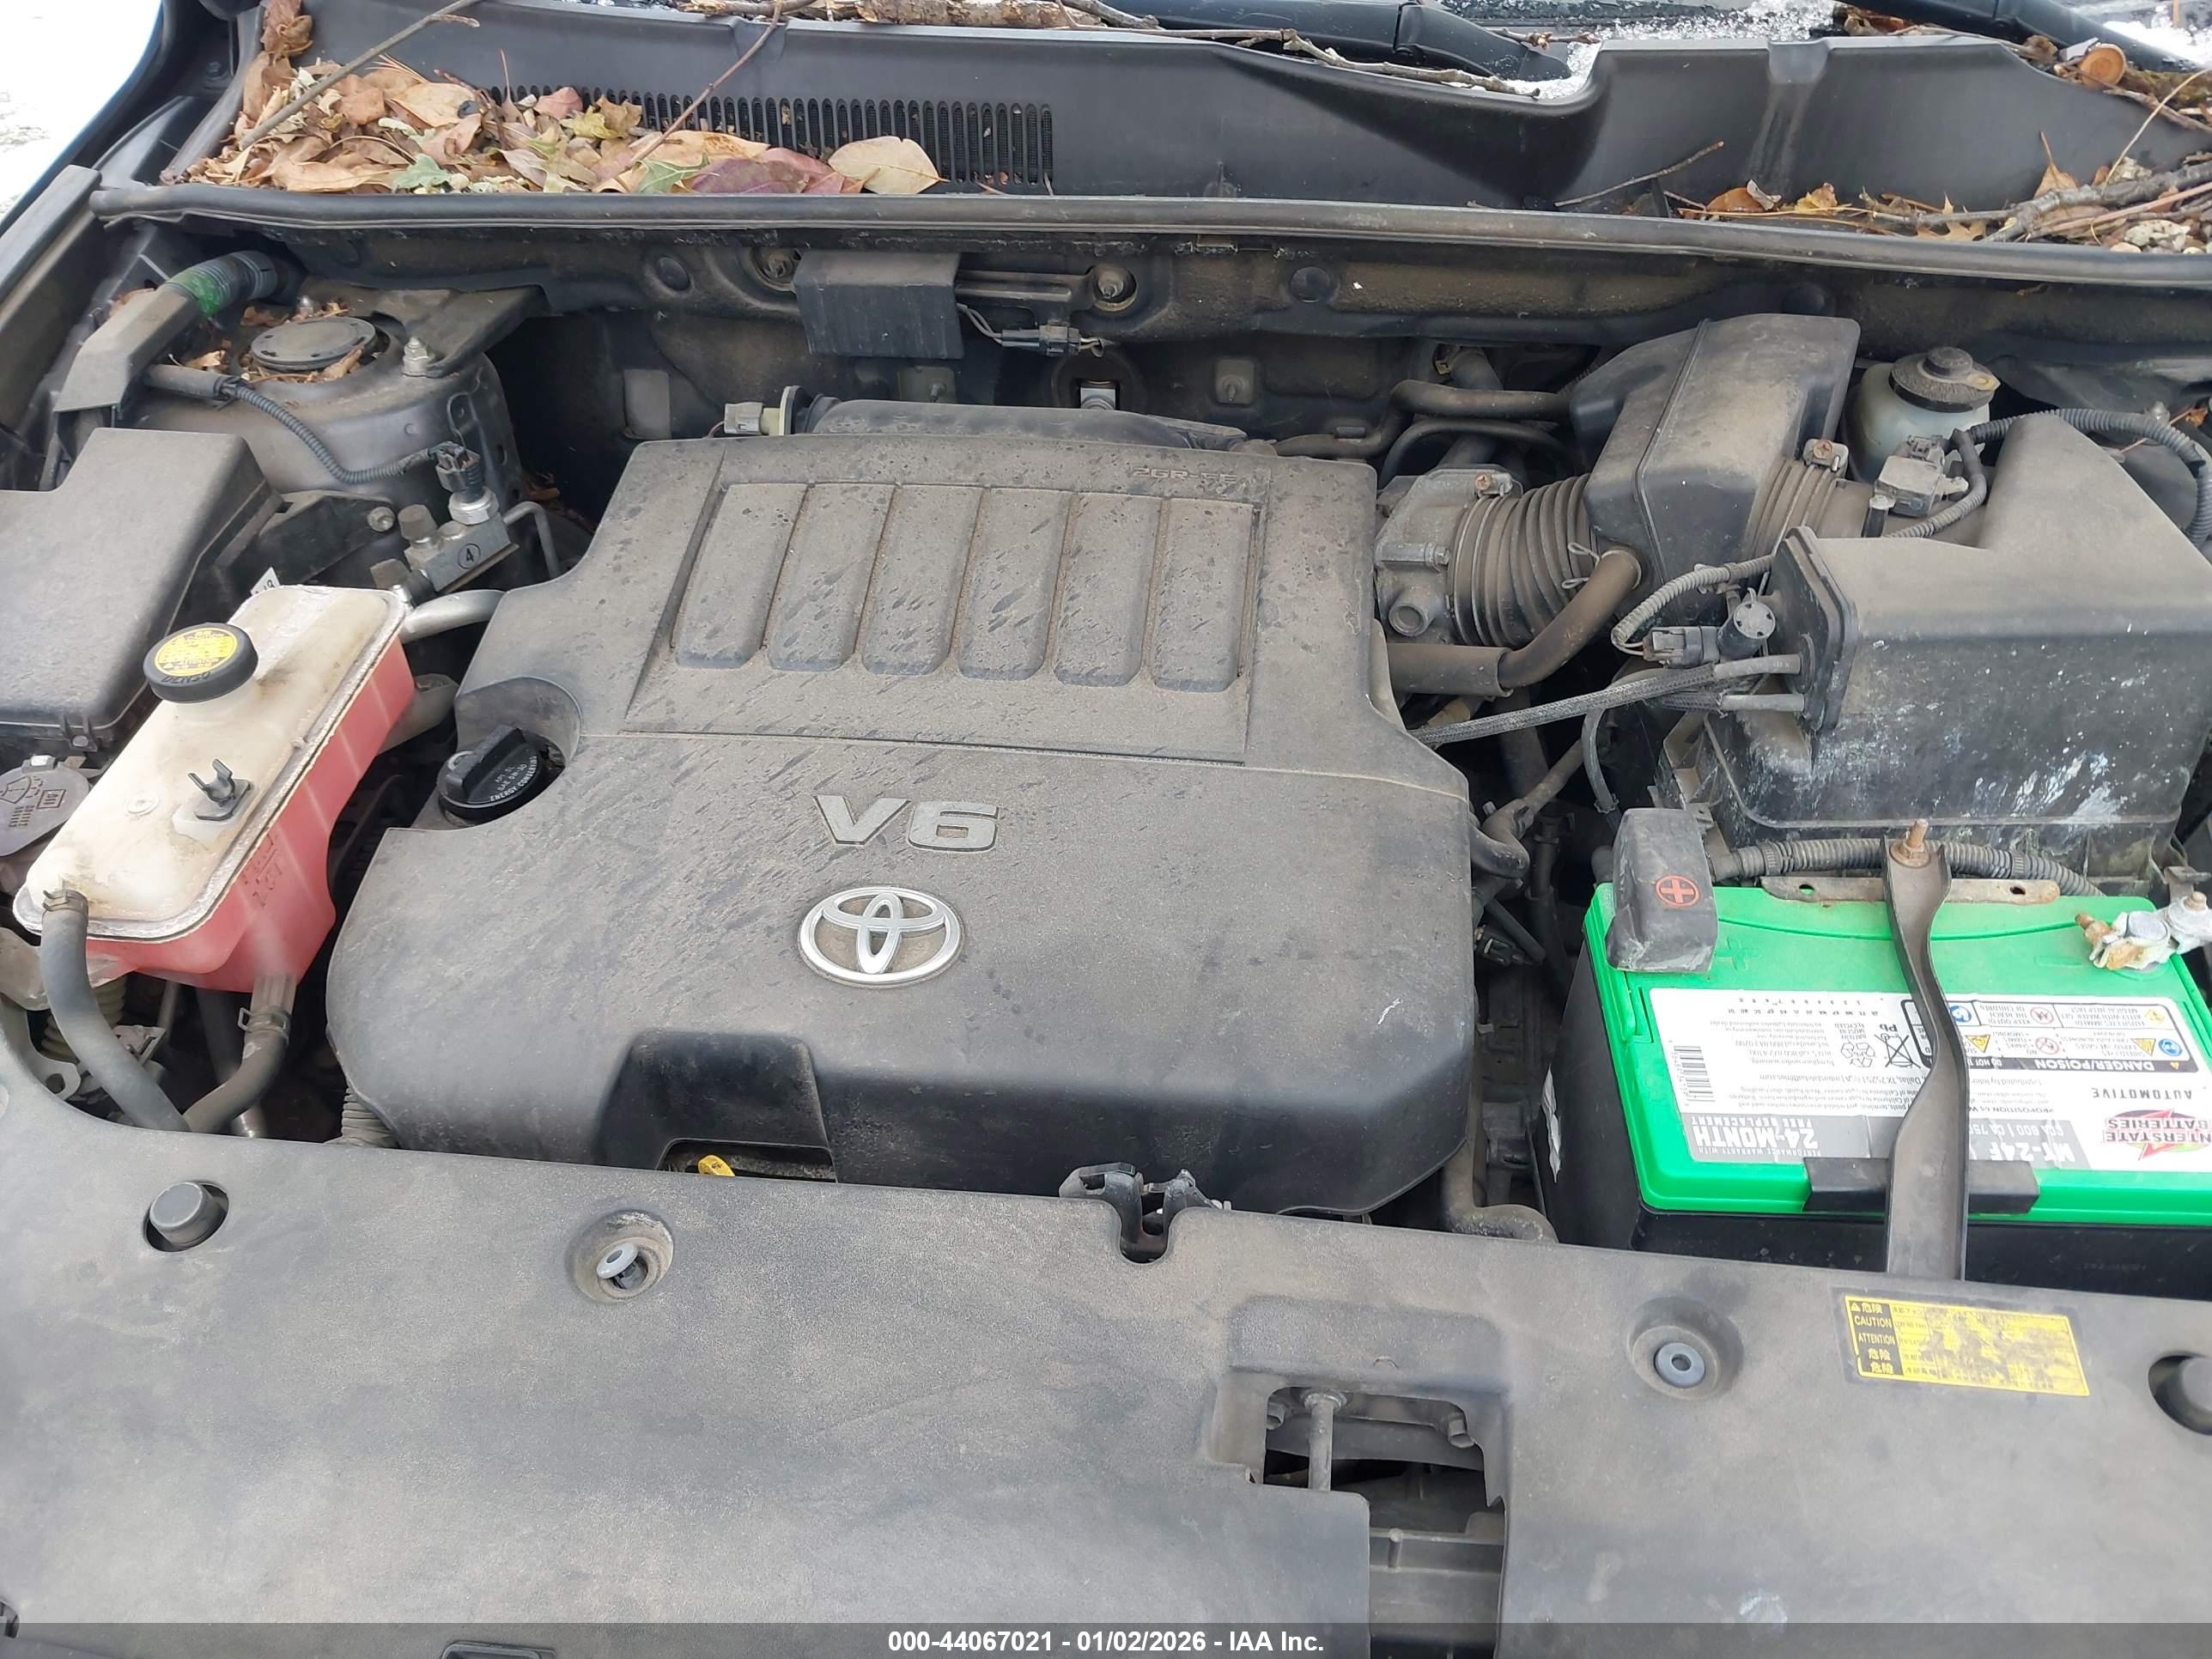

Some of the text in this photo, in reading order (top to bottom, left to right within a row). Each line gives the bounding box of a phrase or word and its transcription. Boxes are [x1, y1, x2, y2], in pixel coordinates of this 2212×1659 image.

[489, 756, 538, 801] ENERGY CONSERVING
[812, 794, 1001, 852] V6
[1880, 1024, 1897, 1032] Pb
[2034, 1059, 2154, 1071] DANGER/POISON
[1897, 1075, 1921, 1085] Dallas,
[2091, 1088, 2192, 1099] AUTOMOTIVE
[1691, 1115, 1813, 1127] FREE REPLACEMENT
[2106, 1120, 2209, 1129] BATTERIES
[1692, 1126, 1819, 1149] 24-MONTH
[2104, 1132, 2211, 1142] NTERSTATE
[1767, 1148, 1821, 1157] PERFORMANCE
[1990, 1141, 2075, 1162] MT-24F
[1854, 1316, 1892, 1328] CAUTION
[1858, 1333, 1896, 1345] ATTENTION
